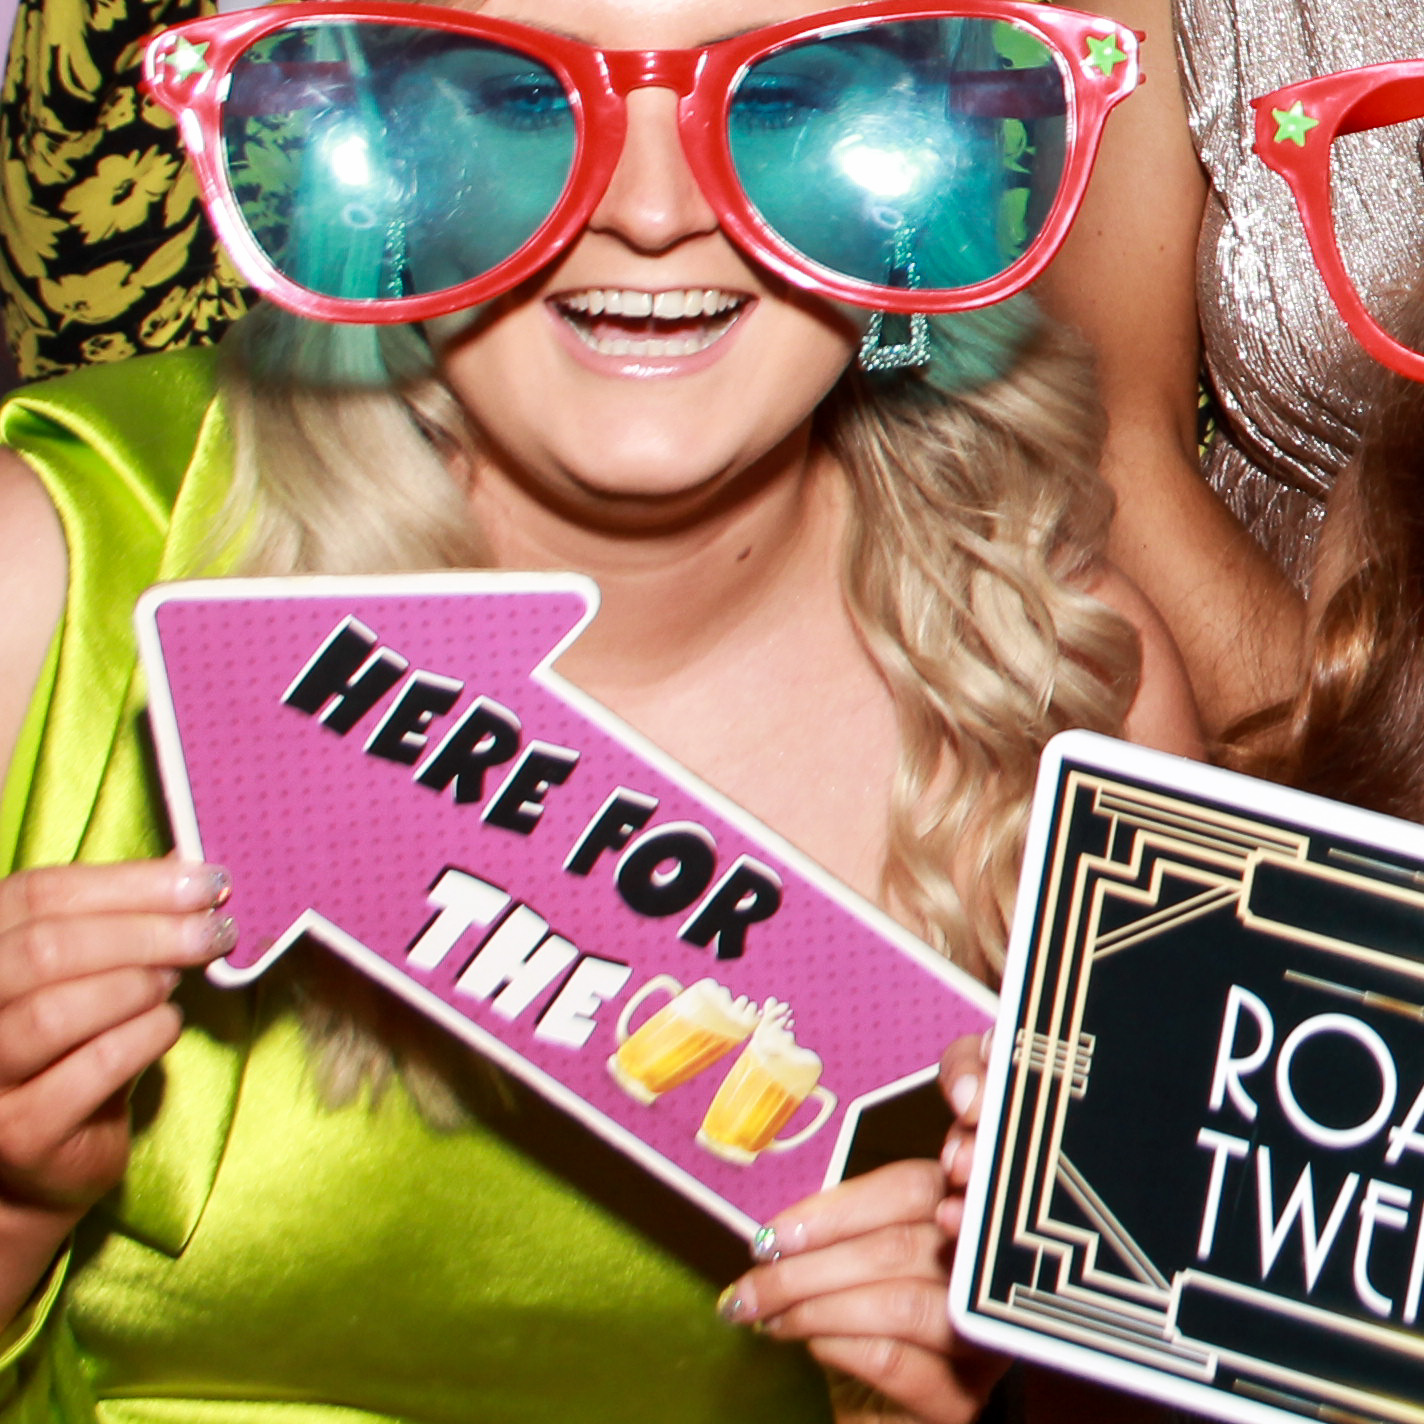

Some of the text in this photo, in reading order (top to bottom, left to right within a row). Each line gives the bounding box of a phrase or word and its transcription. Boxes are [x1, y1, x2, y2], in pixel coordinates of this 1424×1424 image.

[282, 614, 783, 960] HERE FOR
[406, 865, 632, 1050] THE
